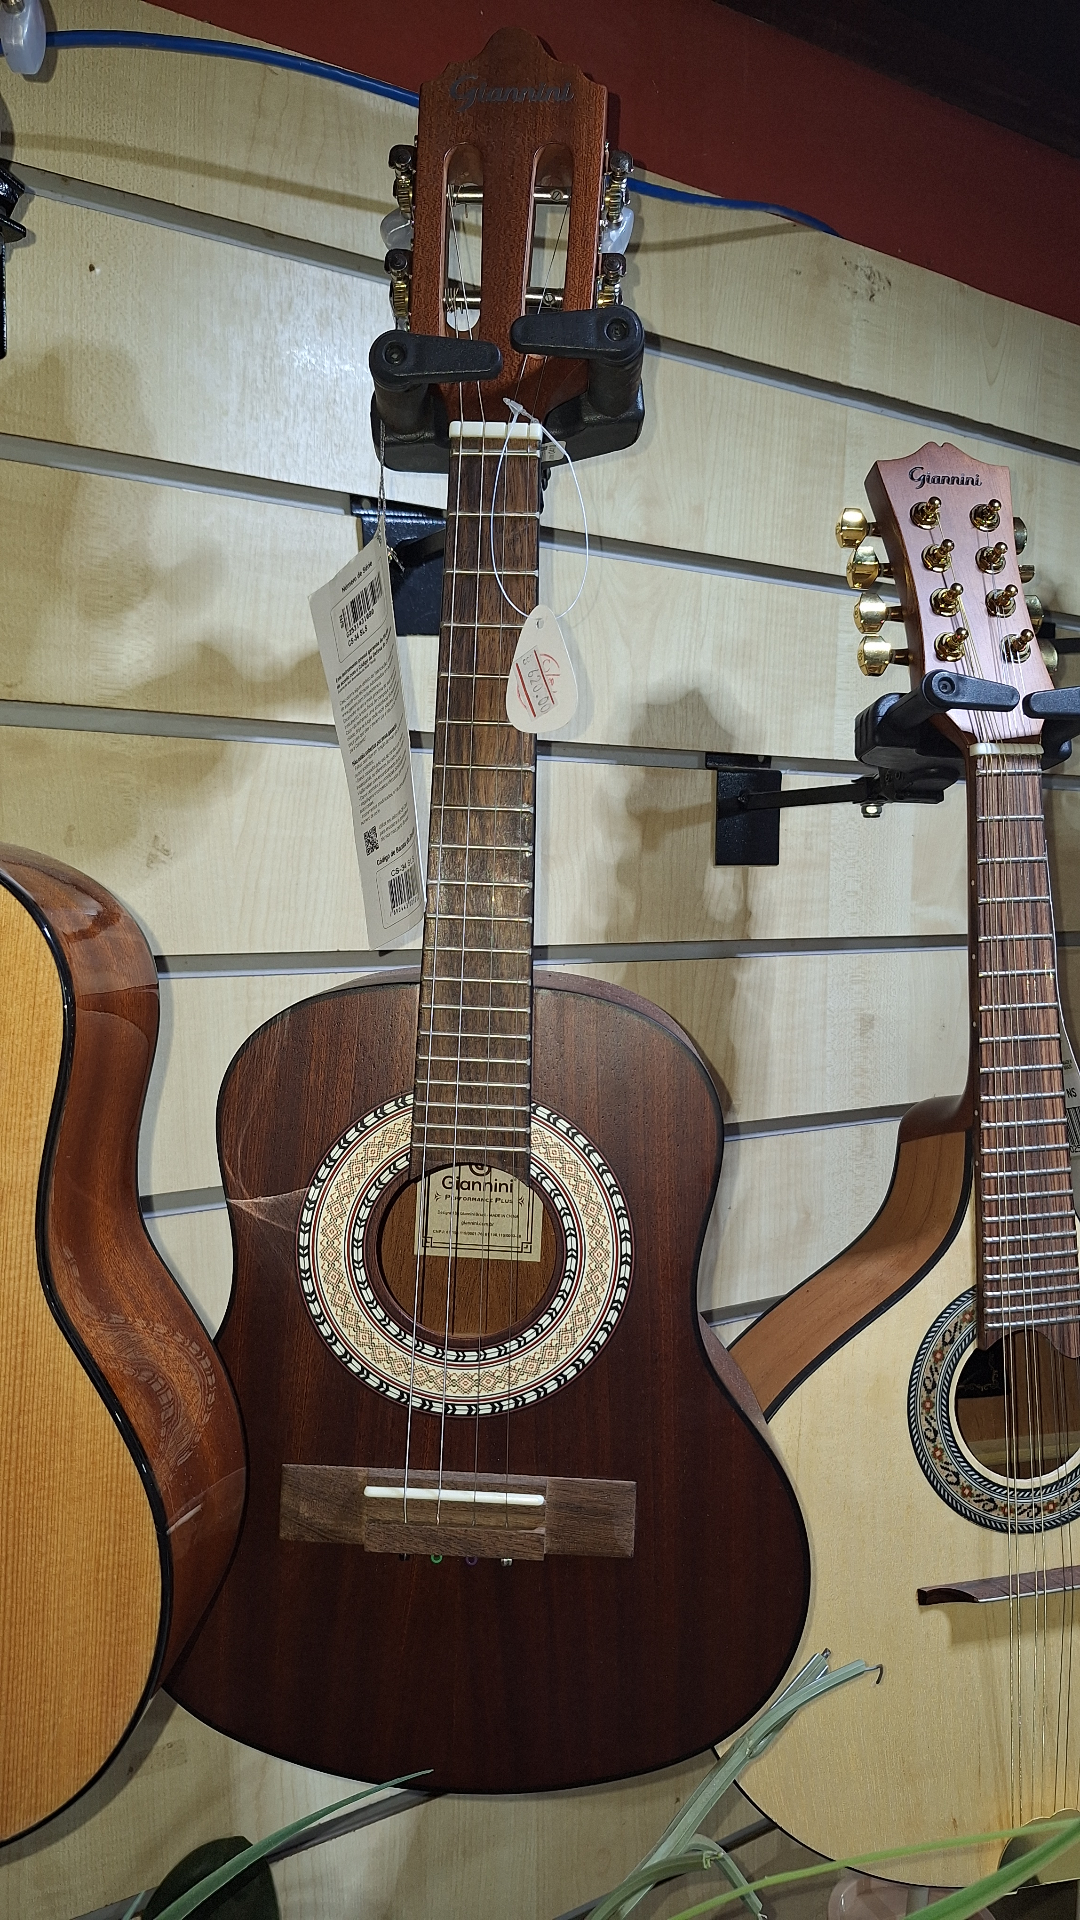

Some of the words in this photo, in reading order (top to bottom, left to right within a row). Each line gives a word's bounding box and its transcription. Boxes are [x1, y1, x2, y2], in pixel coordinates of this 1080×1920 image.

[449, 74, 575, 113] Giannini
[908, 466, 983, 489] Giannini
[527, 668, 552, 714] 620.00
[376, 853, 391, 867] Código
[441, 1175, 514, 1193] Giannini
